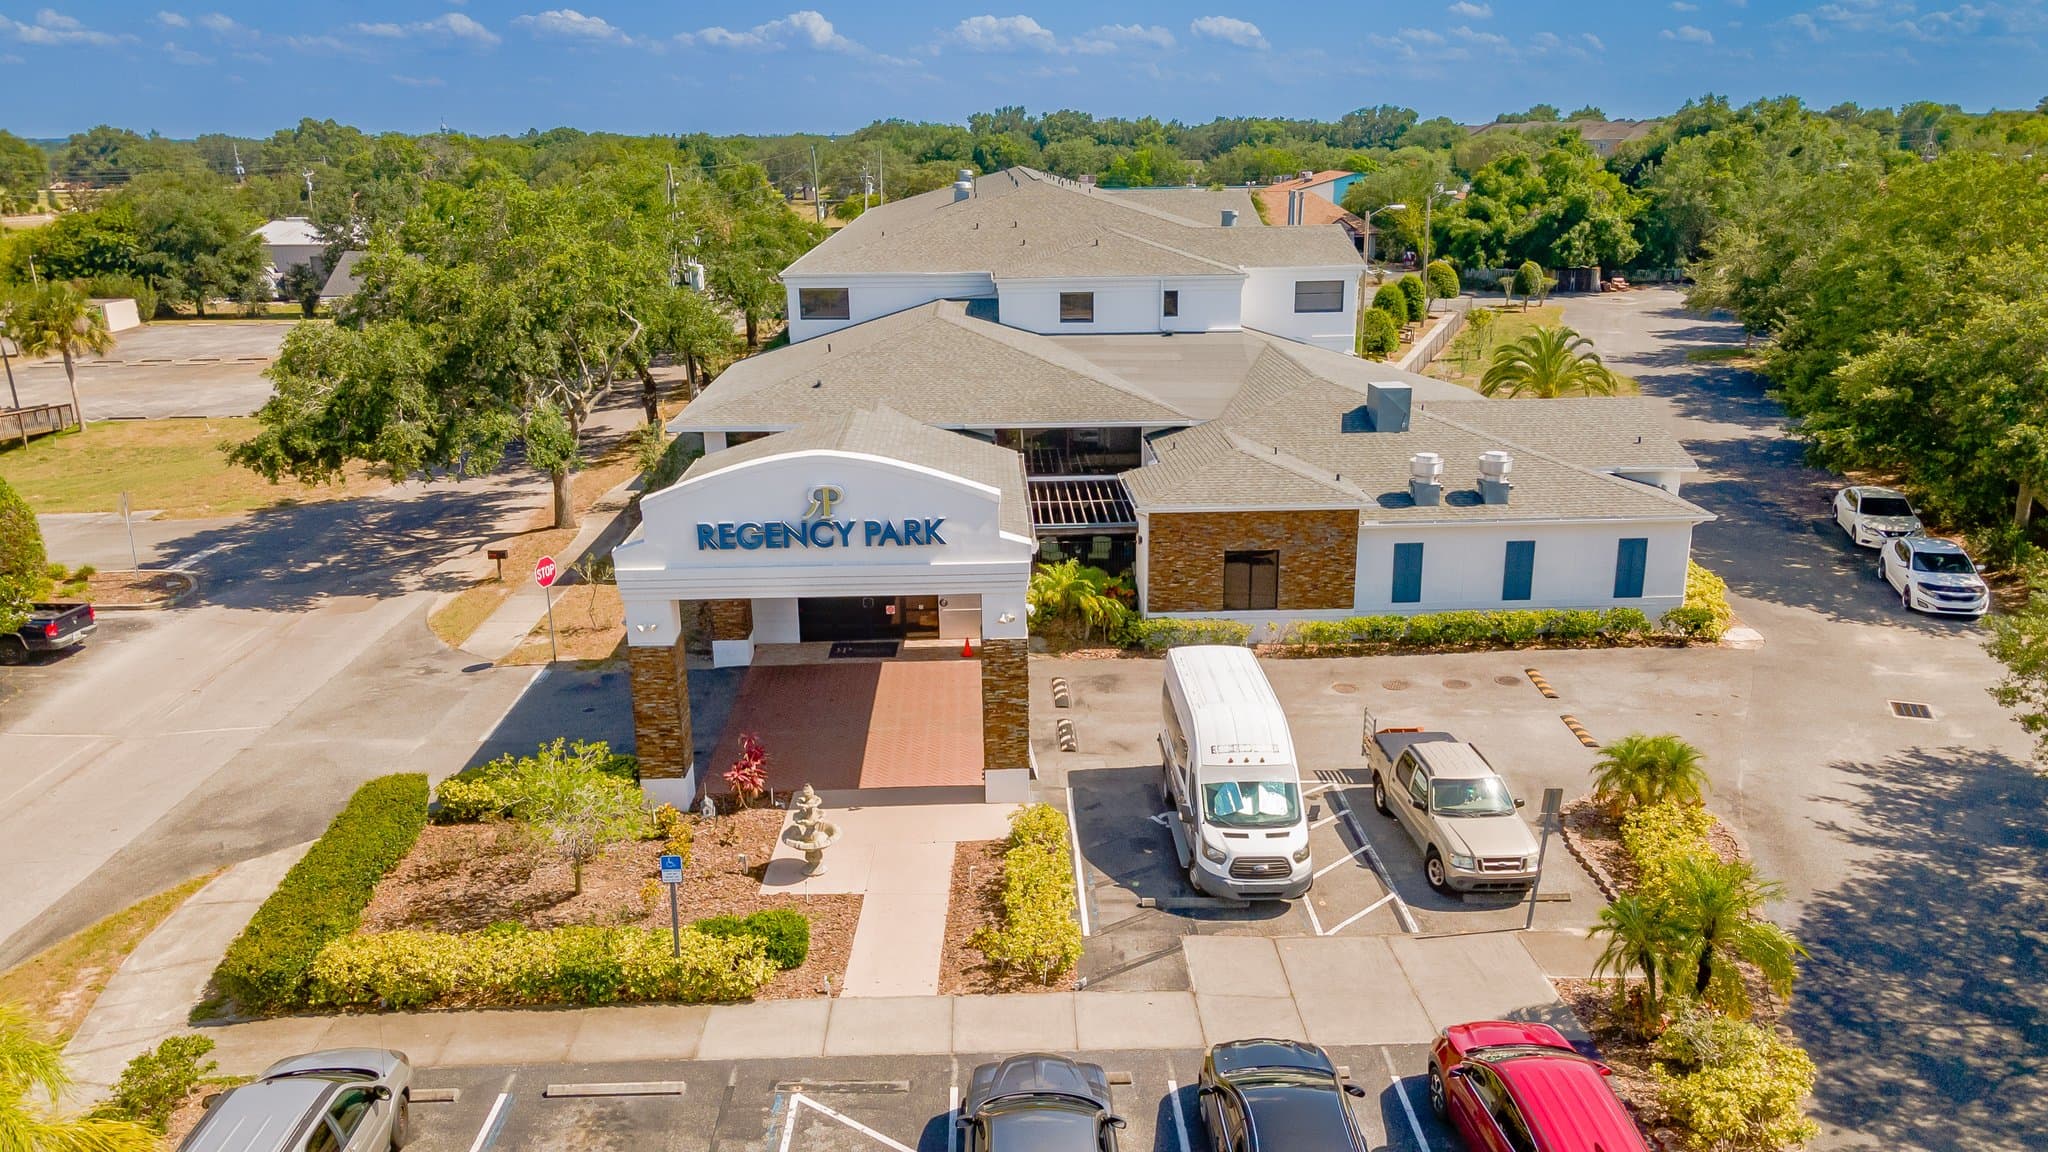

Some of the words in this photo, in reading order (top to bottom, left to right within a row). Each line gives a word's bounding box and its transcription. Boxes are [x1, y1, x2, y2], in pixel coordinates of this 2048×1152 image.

[696, 520, 856, 550] REGENCY
[864, 516, 947, 547] PARK
[537, 564, 554, 580] STOP
